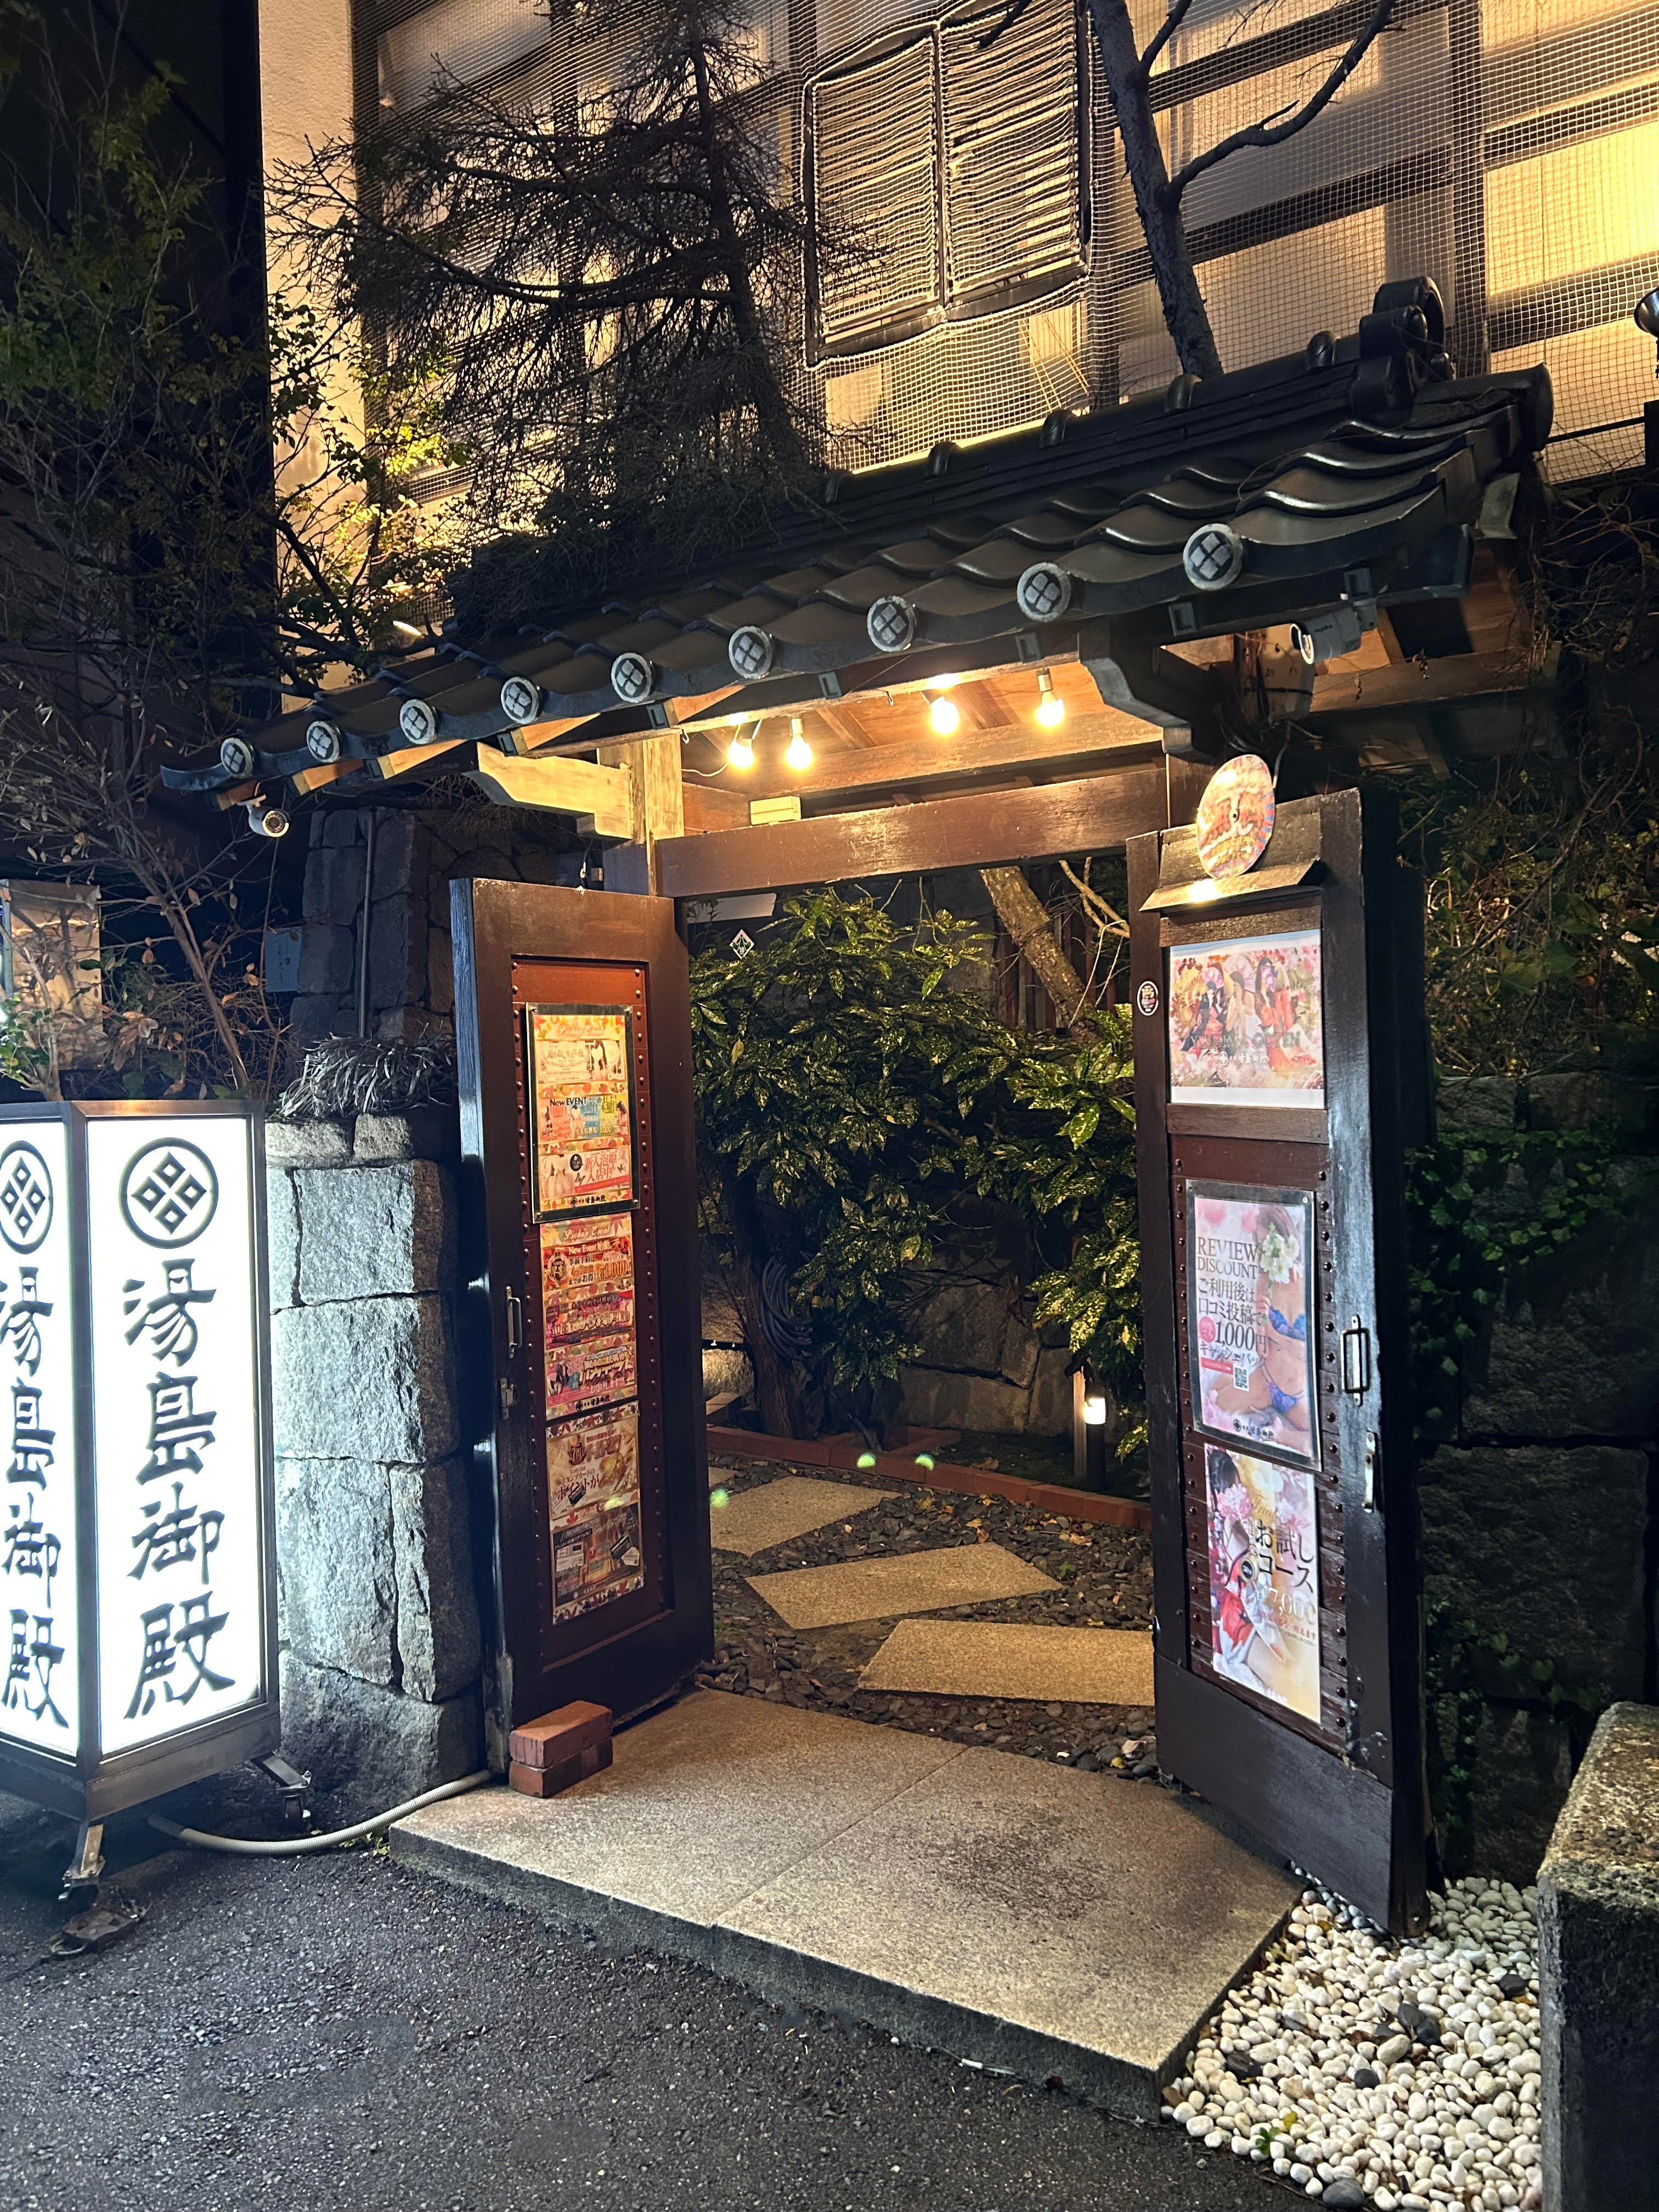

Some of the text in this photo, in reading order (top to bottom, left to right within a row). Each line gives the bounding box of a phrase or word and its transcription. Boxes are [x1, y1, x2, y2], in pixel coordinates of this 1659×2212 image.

[564, 1228, 589, 1240] Pickup
[568, 1246, 582, 1255] New
[1197, 1237, 1258, 1262] REVIEW
[1197, 1256, 1257, 1280] DISCOUNT
[1198, 1277, 1256, 1303] ご利用後は
[1198, 1297, 1262, 1326] 口コミ投稿で
[0, 1266, 69, 1729] 湯島御殿
[122, 1257, 235, 1720] 湯島御殿
[1255, 1518, 1314, 1564] お試し
[1259, 1553, 1313, 1594] コース
